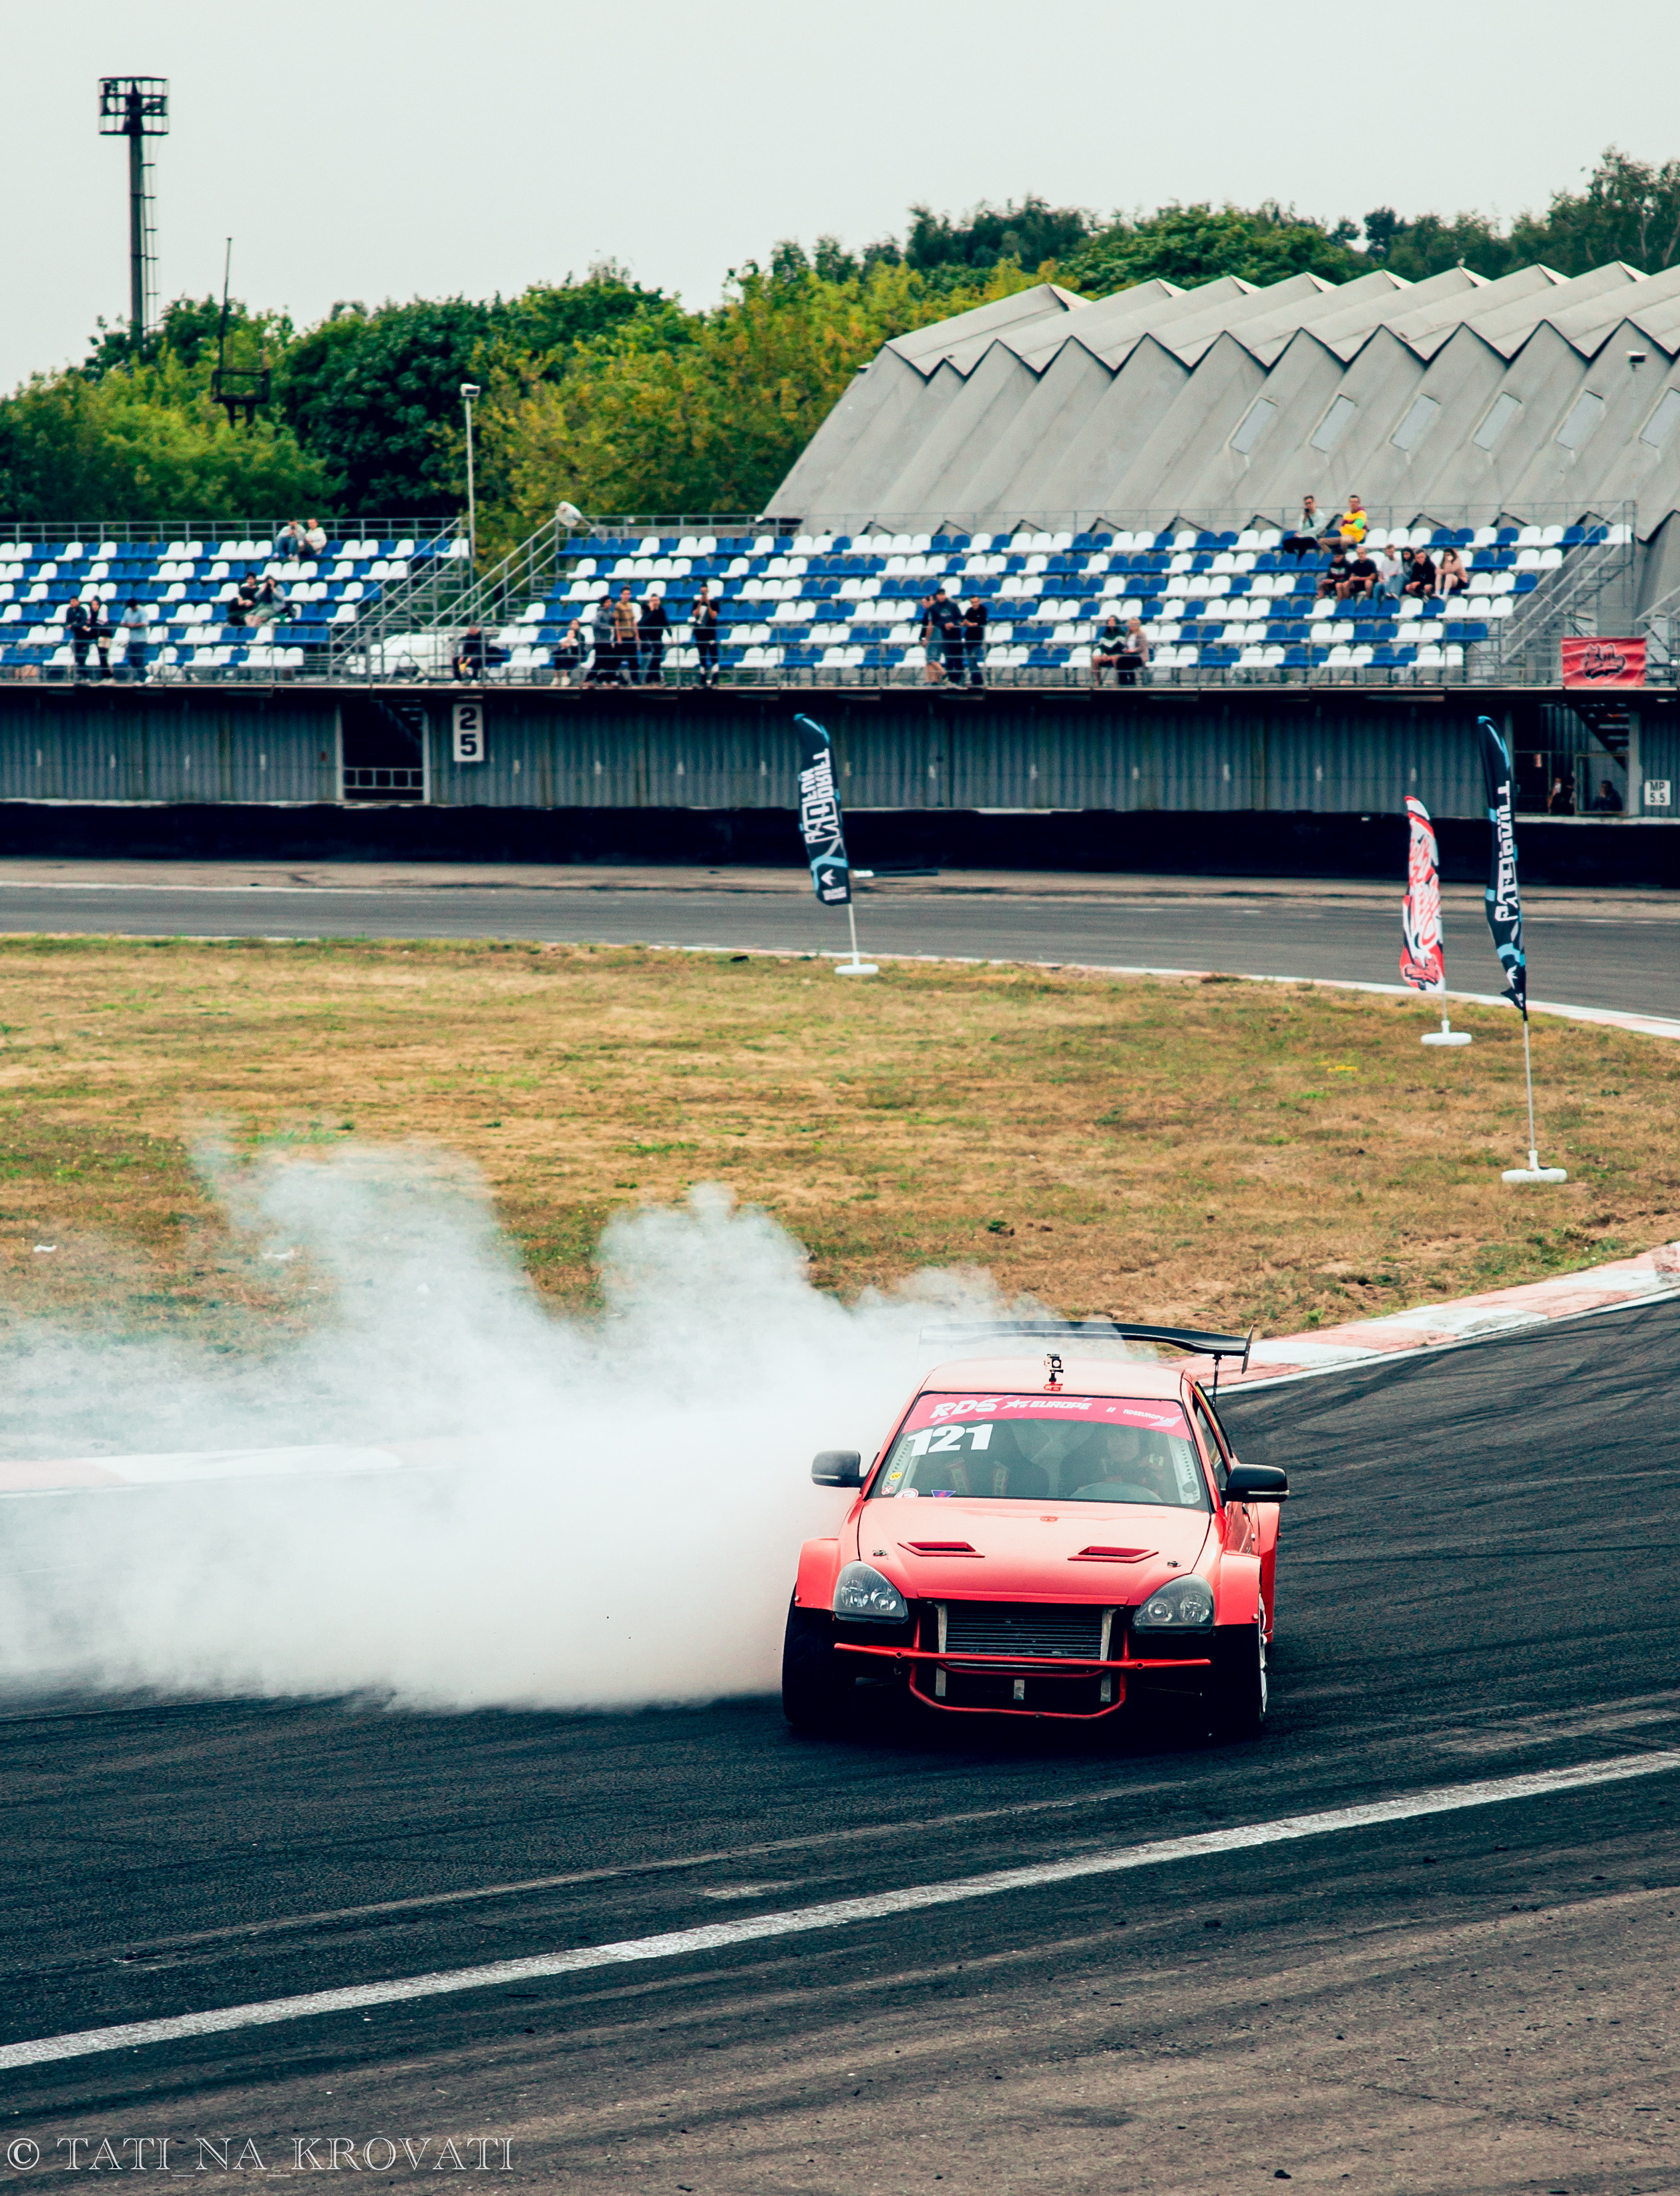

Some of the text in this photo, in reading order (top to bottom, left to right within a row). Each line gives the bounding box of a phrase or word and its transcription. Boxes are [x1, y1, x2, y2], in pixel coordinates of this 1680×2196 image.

[1650, 781, 1665, 791] MP
[1649, 792, 1665, 803] 5.5
[929, 1398, 1004, 1419] RDS
[1030, 1400, 1092, 1410] EUROPE
[907, 1424, 994, 1457] 121
